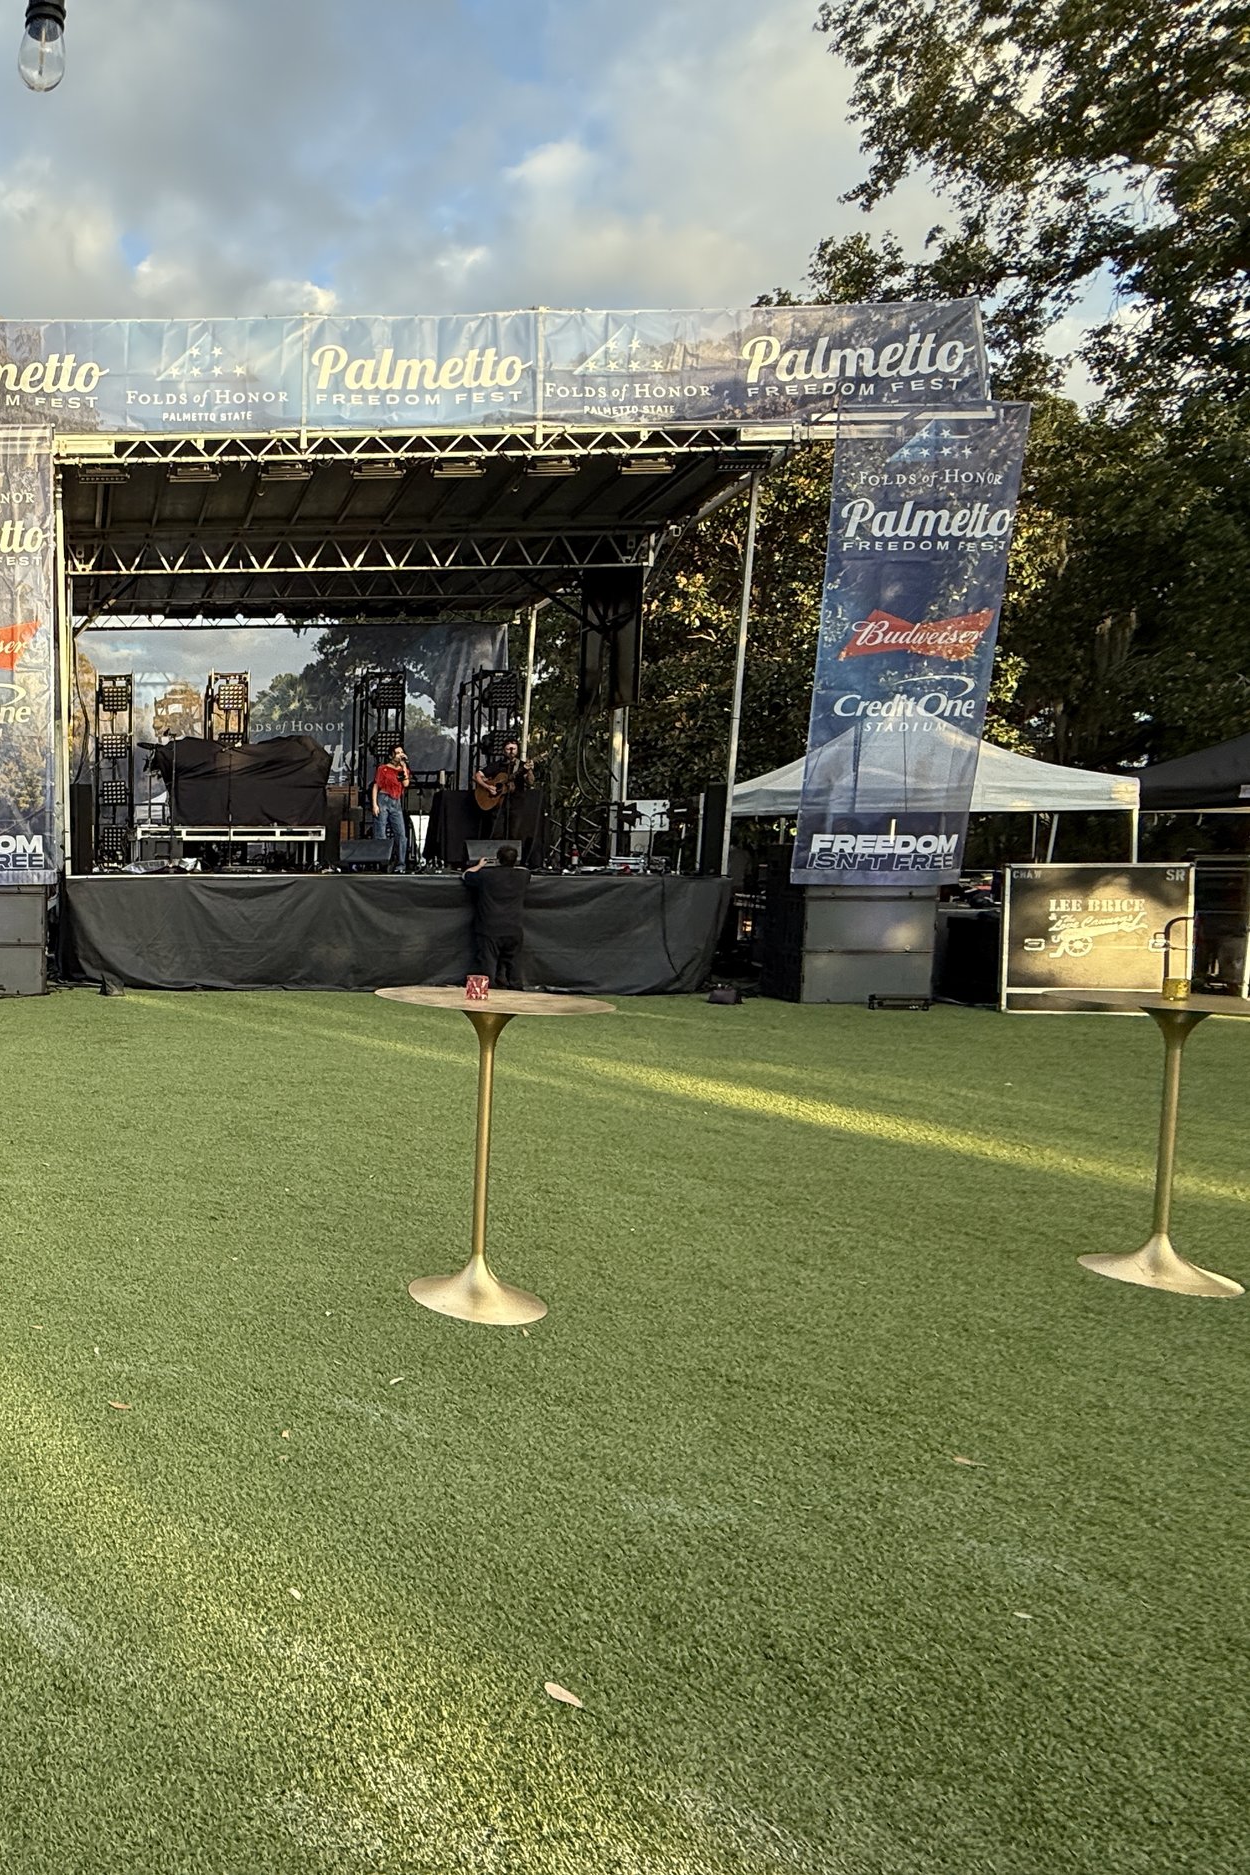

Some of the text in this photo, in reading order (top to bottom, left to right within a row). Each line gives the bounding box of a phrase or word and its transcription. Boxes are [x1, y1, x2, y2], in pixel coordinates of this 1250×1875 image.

[742, 332, 975, 384] Palmetto
[311, 344, 533, 391] Palmetto
[545, 381, 711, 400] FOLDS of HONOR
[747, 377, 964, 397] FREEDOM FEST
[35, 395, 98, 409] FEST
[126, 390, 288, 408] FOLDS of HONOR
[316, 391, 522, 405] FREEDOM FEST
[162, 410, 252, 422] PALMETTO STATE
[584, 403, 676, 415] PALMETTO STATE
[860, 469, 1003, 488] FOLDS of HONOR
[841, 498, 1015, 538] Palmetto
[843, 540, 1007, 551] FREEDOM FEST
[852, 620, 983, 647] Budweiser
[276, 720, 289, 734] of
[291, 720, 345, 732] HONOR
[864, 721, 947, 732] STADIUM
[810, 834, 959, 854] FREEDOM
[806, 853, 954, 871] ISN'T FREE
[1165, 869, 1186, 882] SR
[1049, 898, 1146, 912] LEE BRICE
